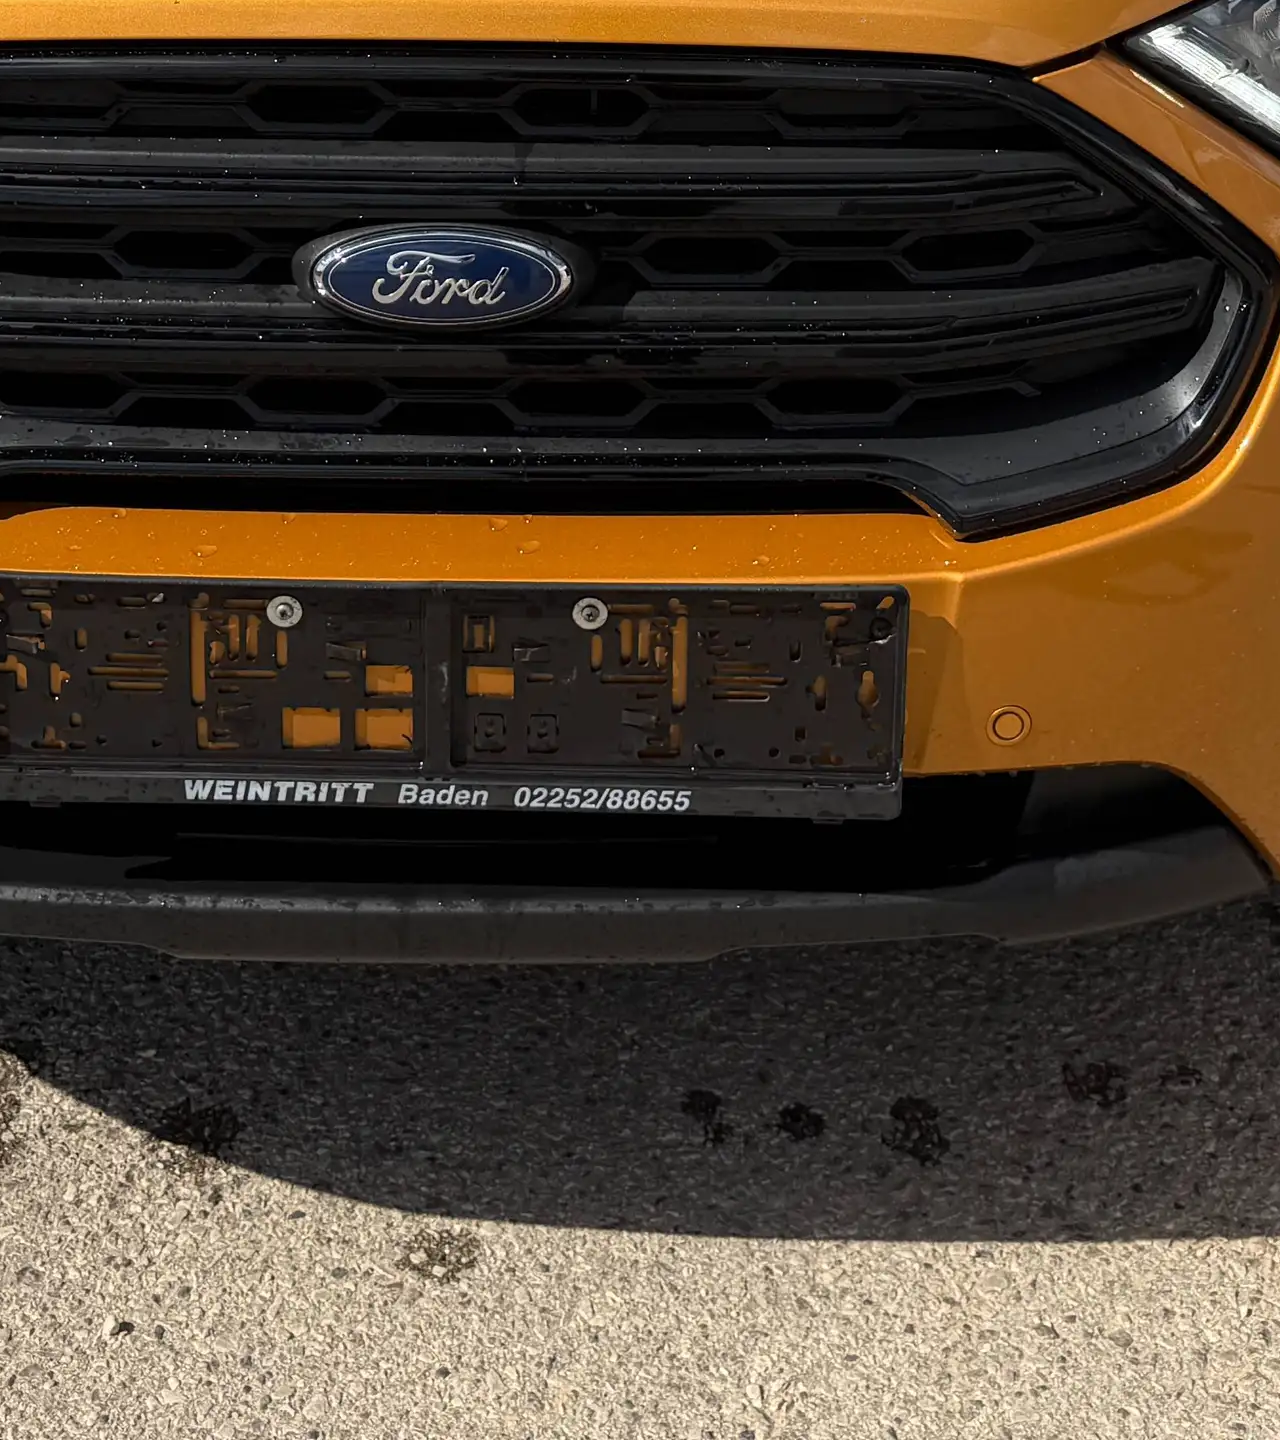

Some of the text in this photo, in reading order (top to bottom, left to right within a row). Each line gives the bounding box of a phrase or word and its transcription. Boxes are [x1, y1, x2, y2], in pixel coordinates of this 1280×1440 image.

[371, 250, 509, 305] Ford
[184, 779, 692, 812] WEINTRITT Baden 02252/88655
